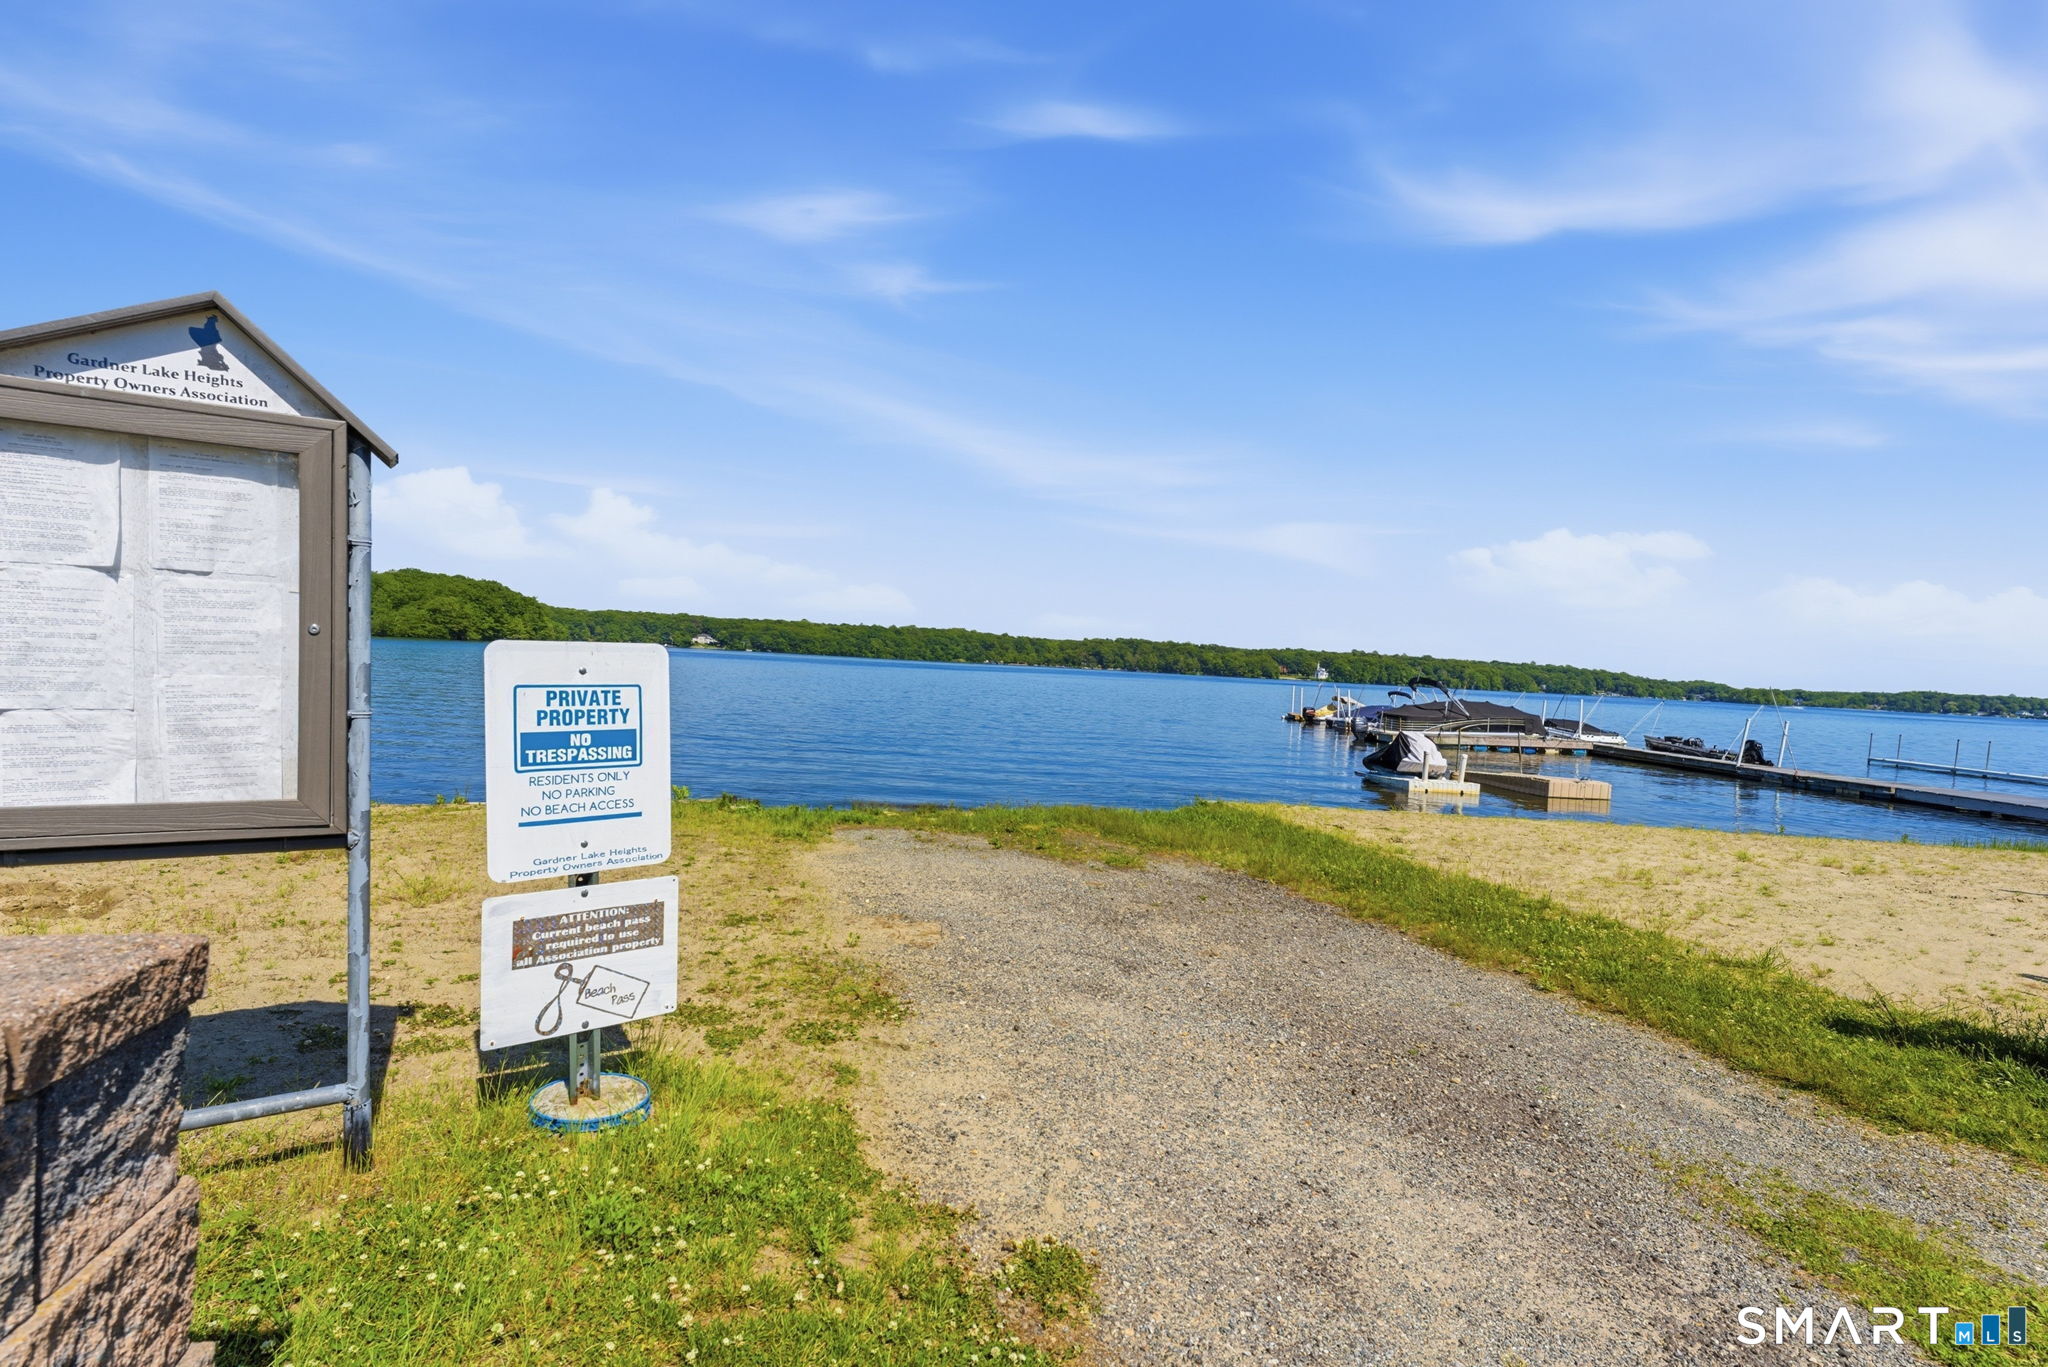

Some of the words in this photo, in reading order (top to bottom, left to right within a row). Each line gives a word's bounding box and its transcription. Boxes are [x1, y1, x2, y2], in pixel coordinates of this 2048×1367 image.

[67, 352, 138, 373] Gardner
[142, 364, 180, 380] Lake
[184, 370, 244, 388] Heights
[33, 364, 109, 389] Property
[114, 377, 176, 396] Owners
[180, 386, 269, 408] Association
[545, 690, 622, 707] PRIVATE
[536, 708, 630, 726] PROPERTY
[570, 733, 592, 747] NO
[525, 745, 633, 764] TRESPASSING
[528, 773, 594, 787] RESIDENTS
[597, 771, 631, 783] ONLY
[542, 789, 562, 801] NO
[565, 785, 616, 800] PARKING
[520, 806, 542, 817] NO
[545, 801, 587, 815] BEACH
[589, 798, 635, 812] ACCESS
[532, 855, 578, 866] Gardner
[581, 850, 606, 860] Lake
[609, 845, 648, 857] Heights
[510, 867, 559, 879] Property
[562, 860, 603, 871] Owners
[606, 852, 664, 865] Association
[559, 906, 630, 925] ATTENTION:
[531, 926, 581, 941] Current
[585, 919, 621, 932] beach
[624, 915, 651, 928] pass
[545, 934, 600, 950] required
[602, 932, 615, 942] to
[619, 929, 640, 939] use
[535, 943, 609, 966] Association
[612, 936, 661, 954] property
[584, 983, 617, 999] Beach
[611, 991, 637, 1006] Pass
